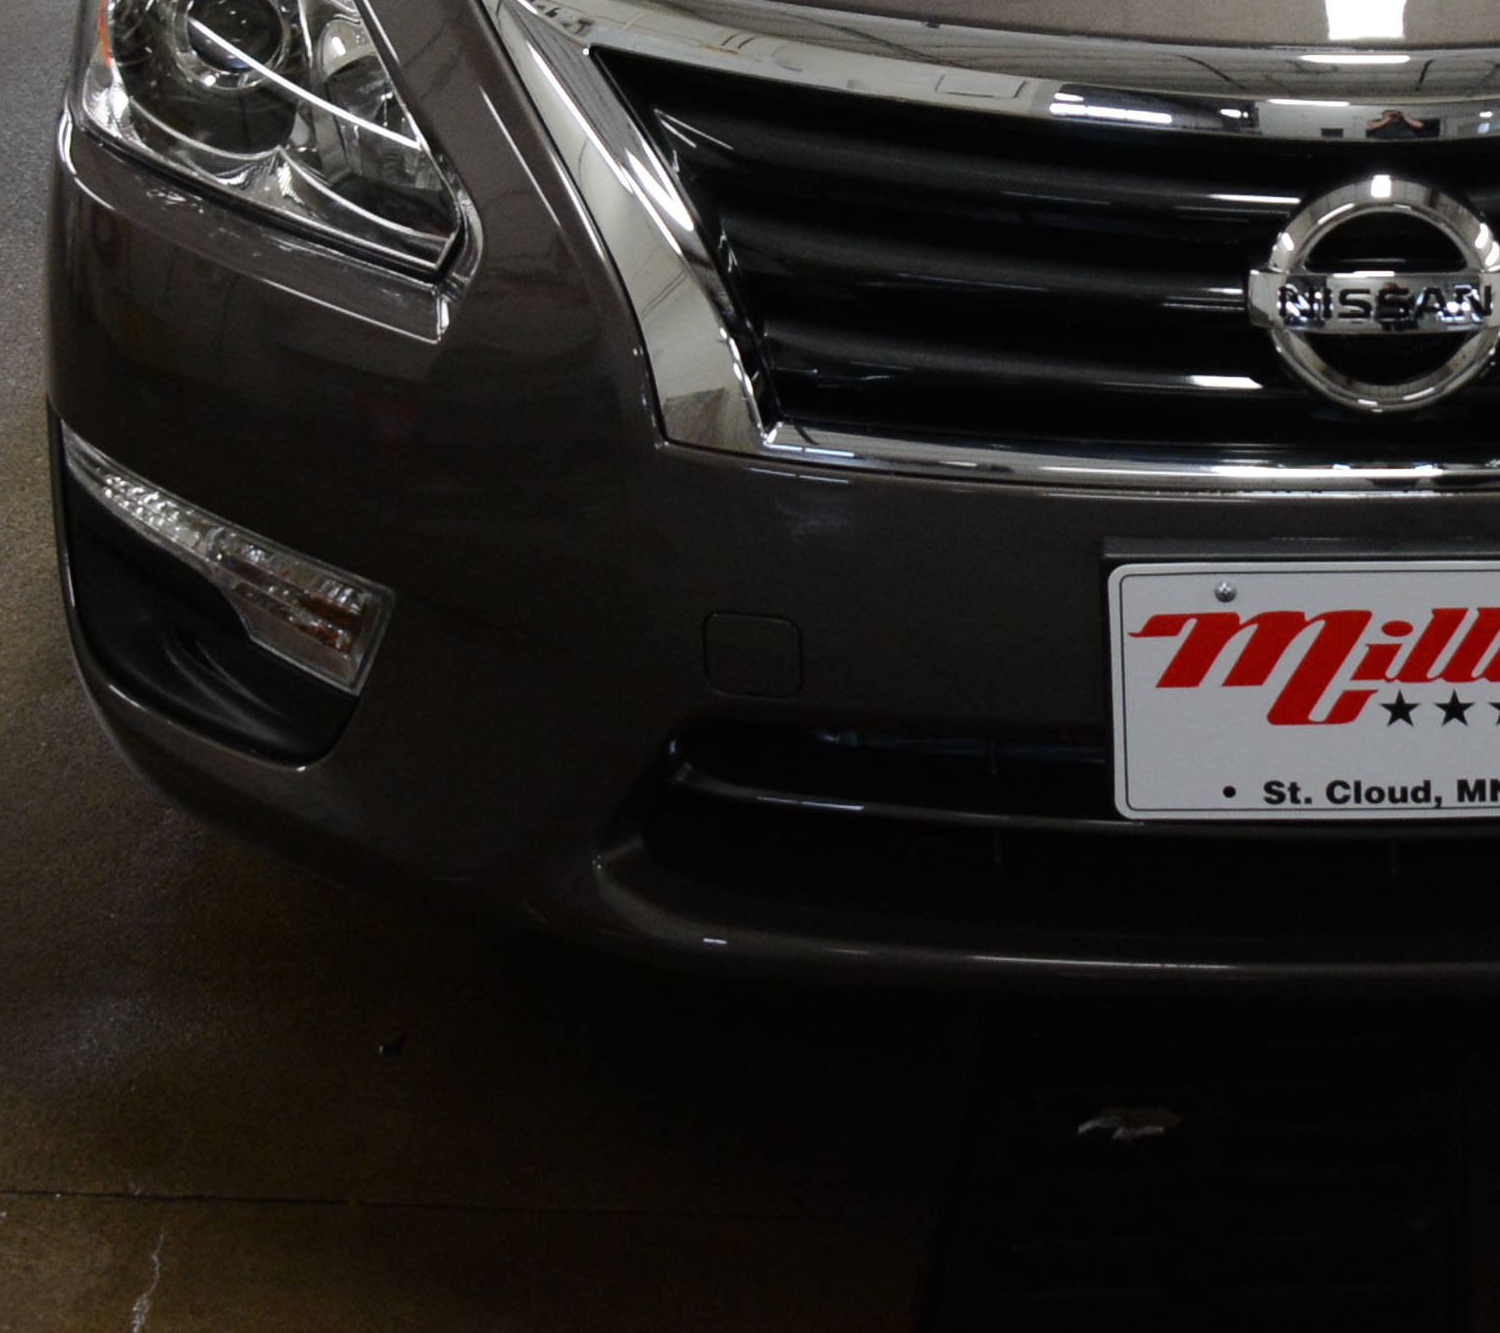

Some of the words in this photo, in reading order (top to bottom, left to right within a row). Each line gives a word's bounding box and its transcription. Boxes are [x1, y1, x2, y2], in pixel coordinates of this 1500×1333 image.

[1277, 283, 1493, 321] NISSAN
[1262, 779, 1313, 805] St.
[1325, 779, 1443, 808] Cloud,
